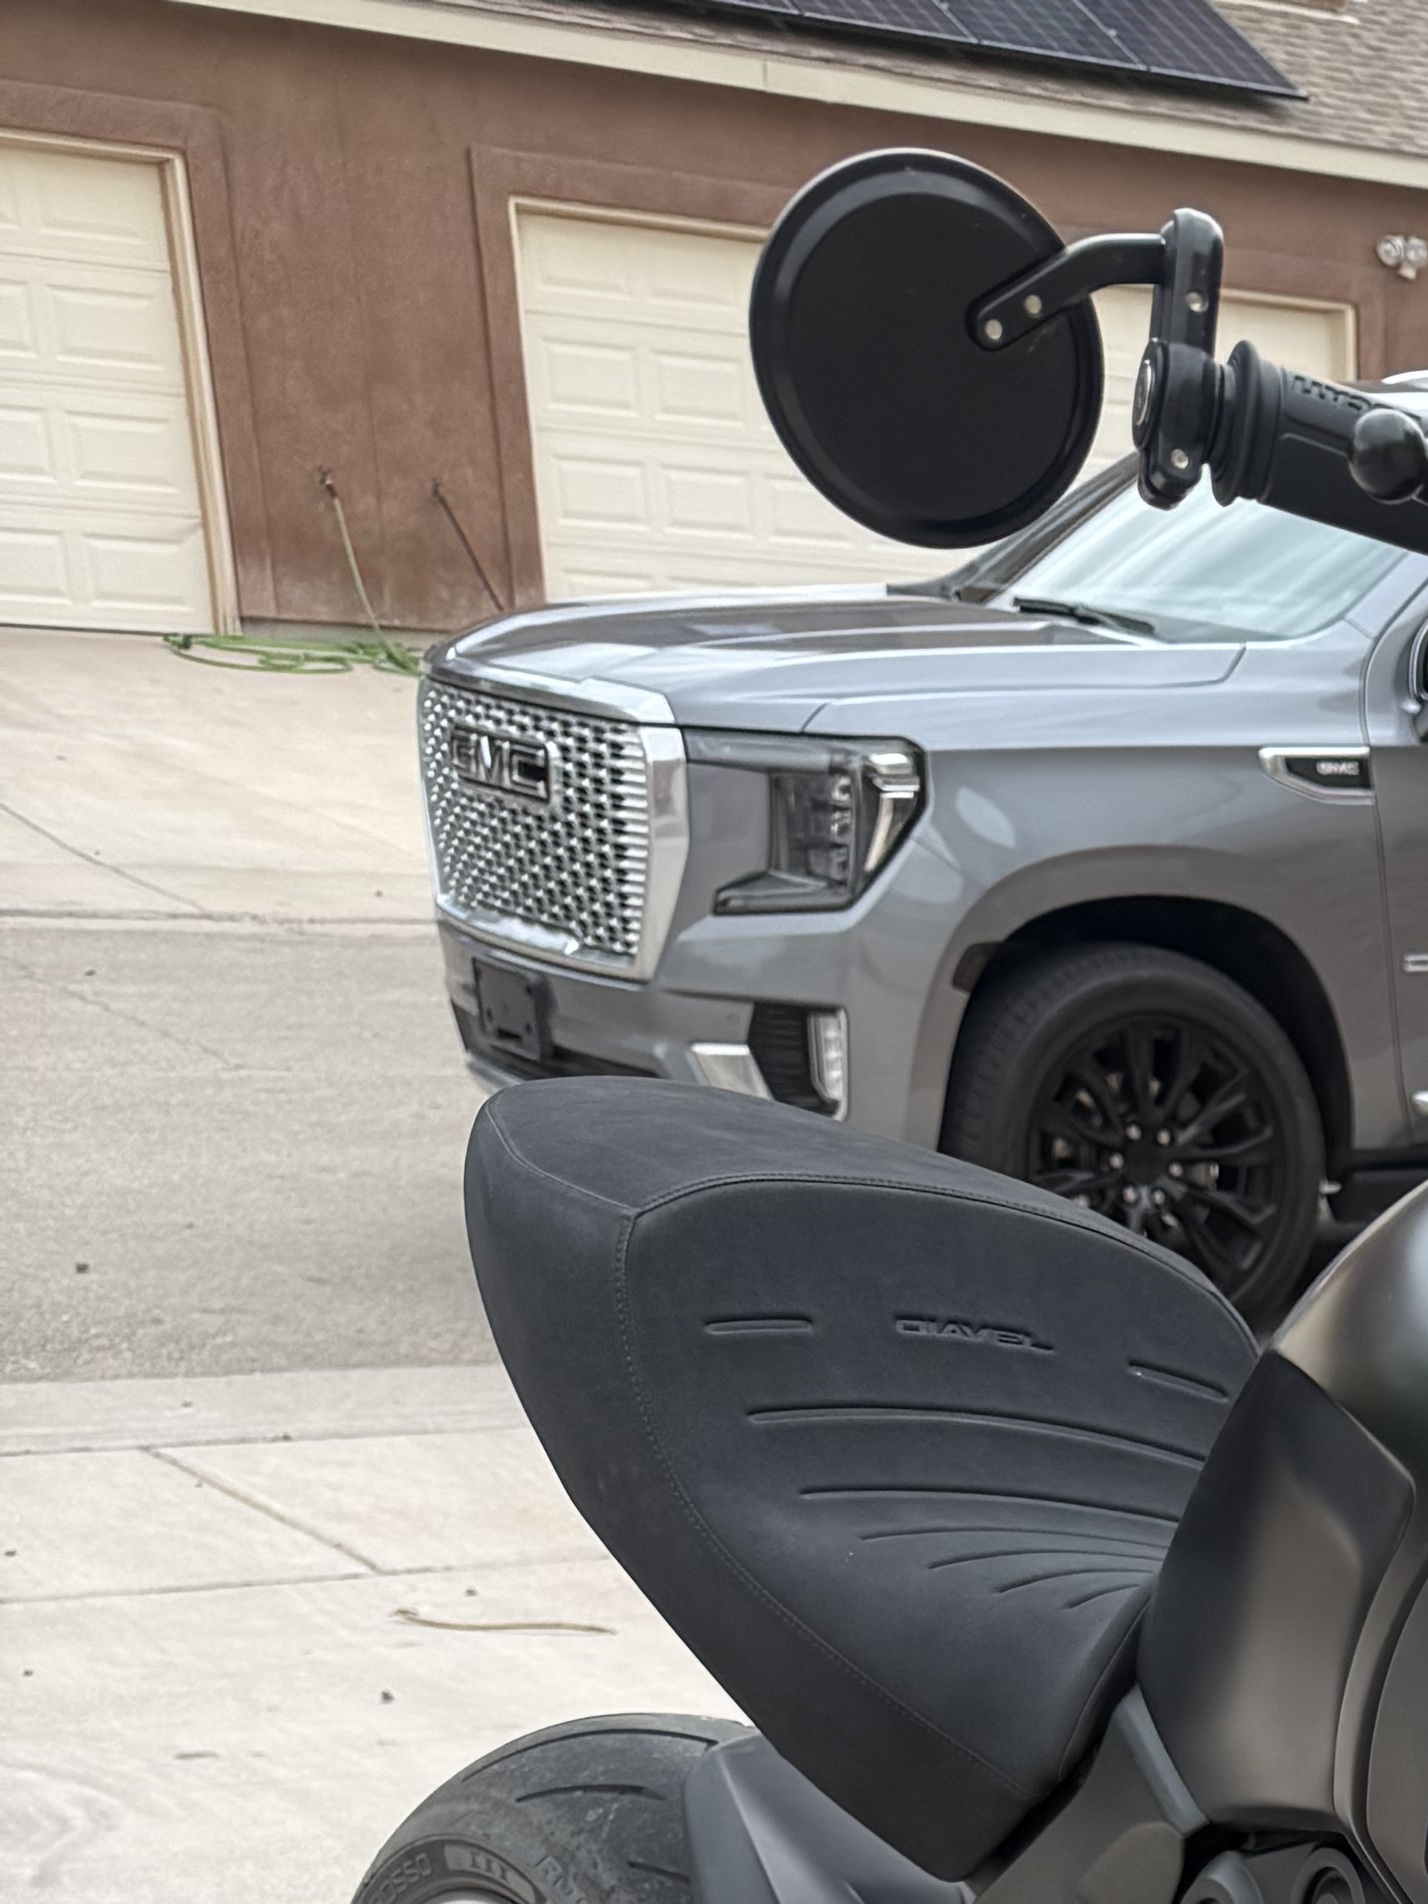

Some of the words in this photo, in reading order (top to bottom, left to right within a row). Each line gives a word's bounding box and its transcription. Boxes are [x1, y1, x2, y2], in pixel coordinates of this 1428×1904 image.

[452, 729, 549, 800] GMC
[1315, 760, 1360, 777] GMC
[895, 1314, 1055, 1352] DIAVEL
